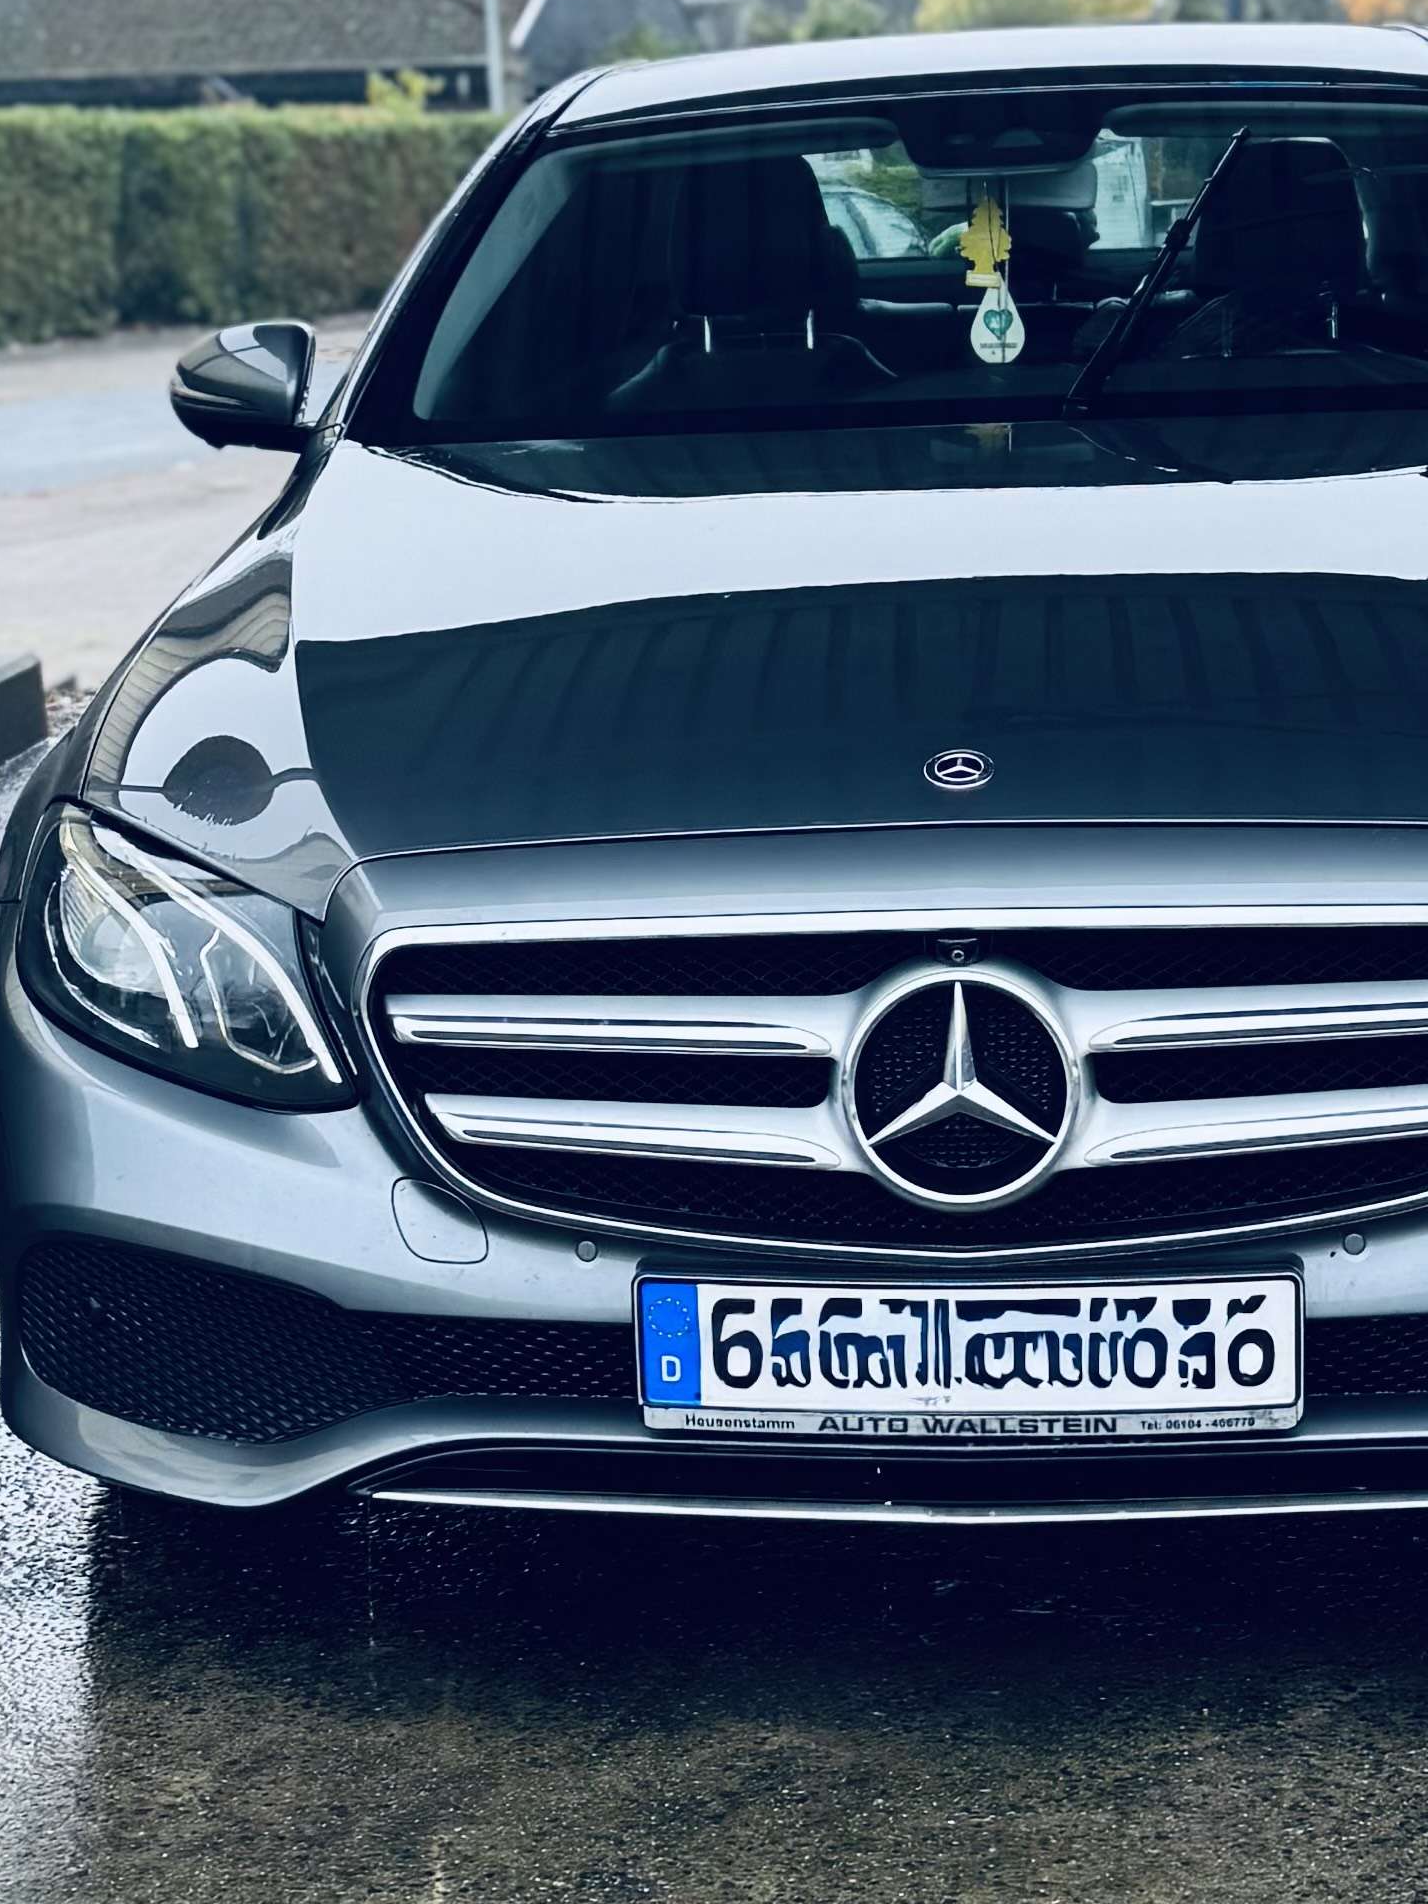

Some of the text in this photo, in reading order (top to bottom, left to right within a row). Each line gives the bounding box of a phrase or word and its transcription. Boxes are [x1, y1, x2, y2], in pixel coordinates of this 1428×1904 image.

[661, 1355, 682, 1382] D
[818, 1415, 1118, 1434] AUTO WALLSTEIN
